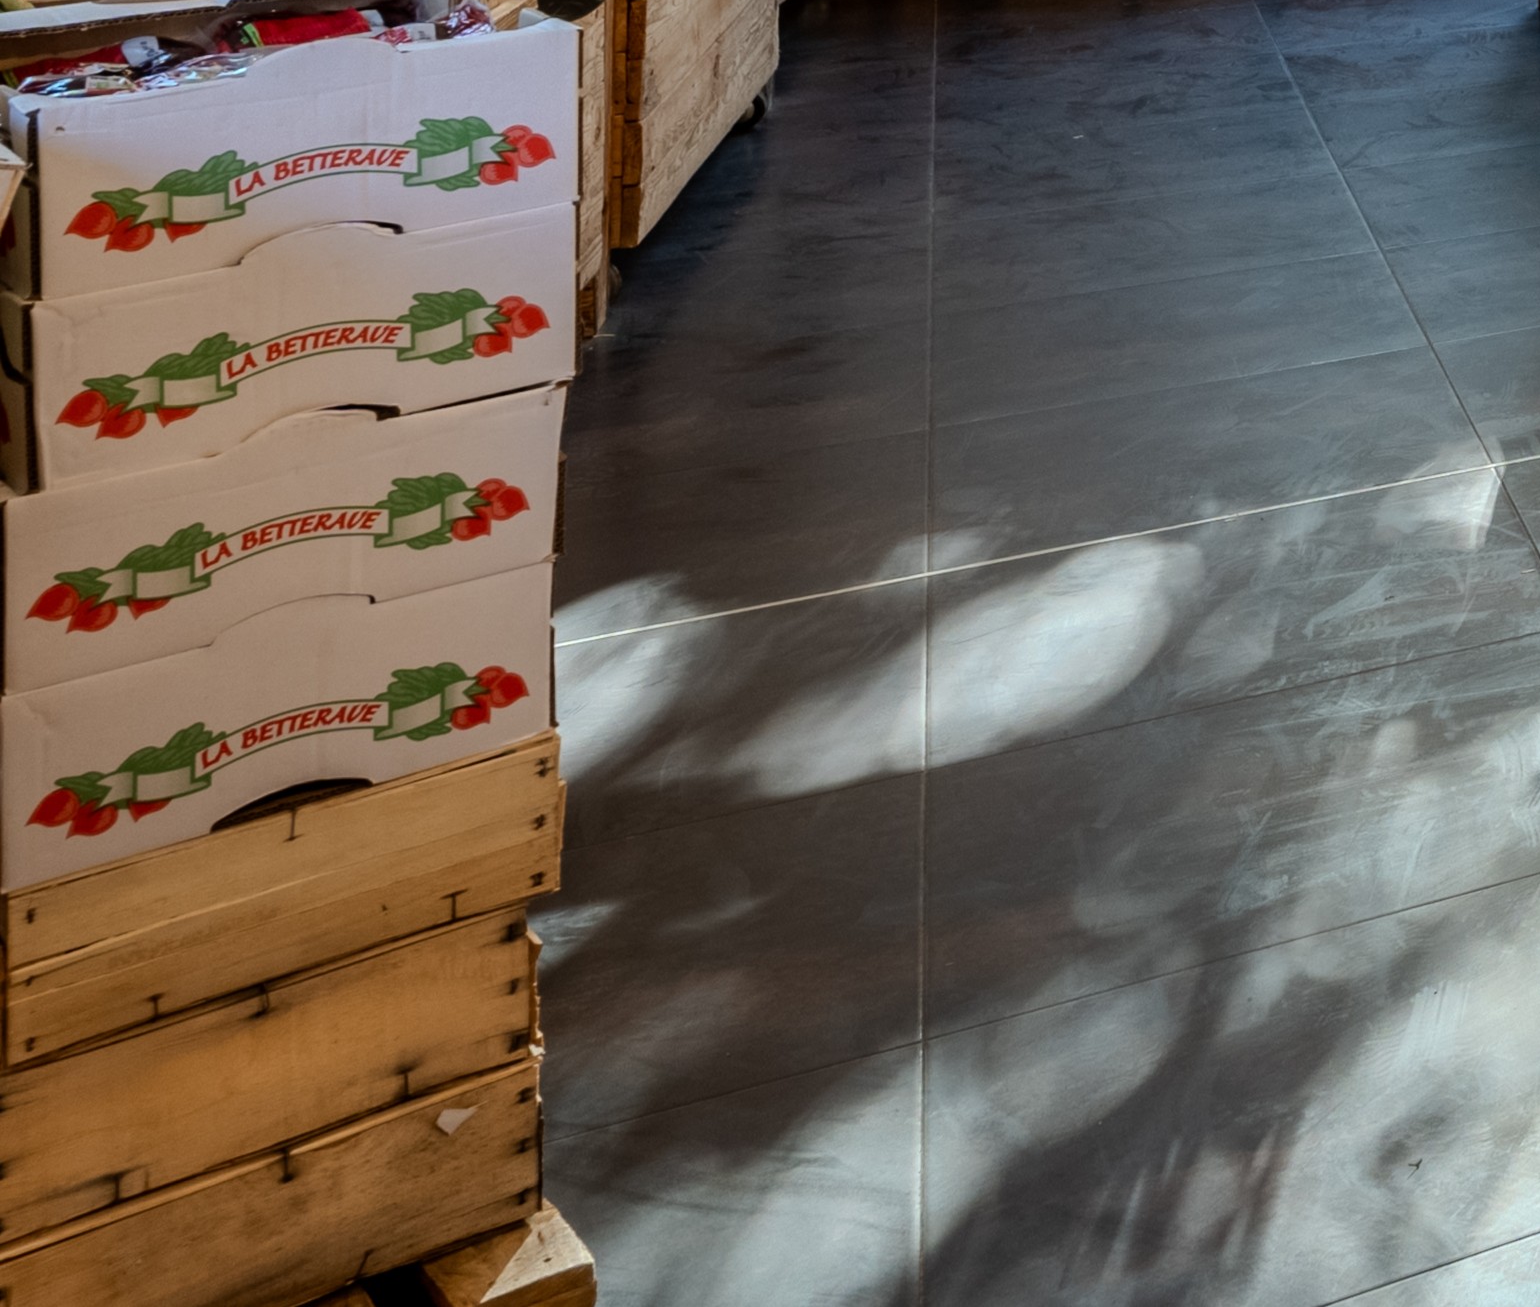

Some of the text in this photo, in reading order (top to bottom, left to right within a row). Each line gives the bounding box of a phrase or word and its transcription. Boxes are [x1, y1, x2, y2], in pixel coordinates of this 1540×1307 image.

[232, 145, 409, 199] LA BETTERAVE
[225, 323, 404, 380] LA BETTERAVE
[199, 509, 382, 570] LA BETTERAVE
[199, 703, 382, 770] LA BETTERAVE
